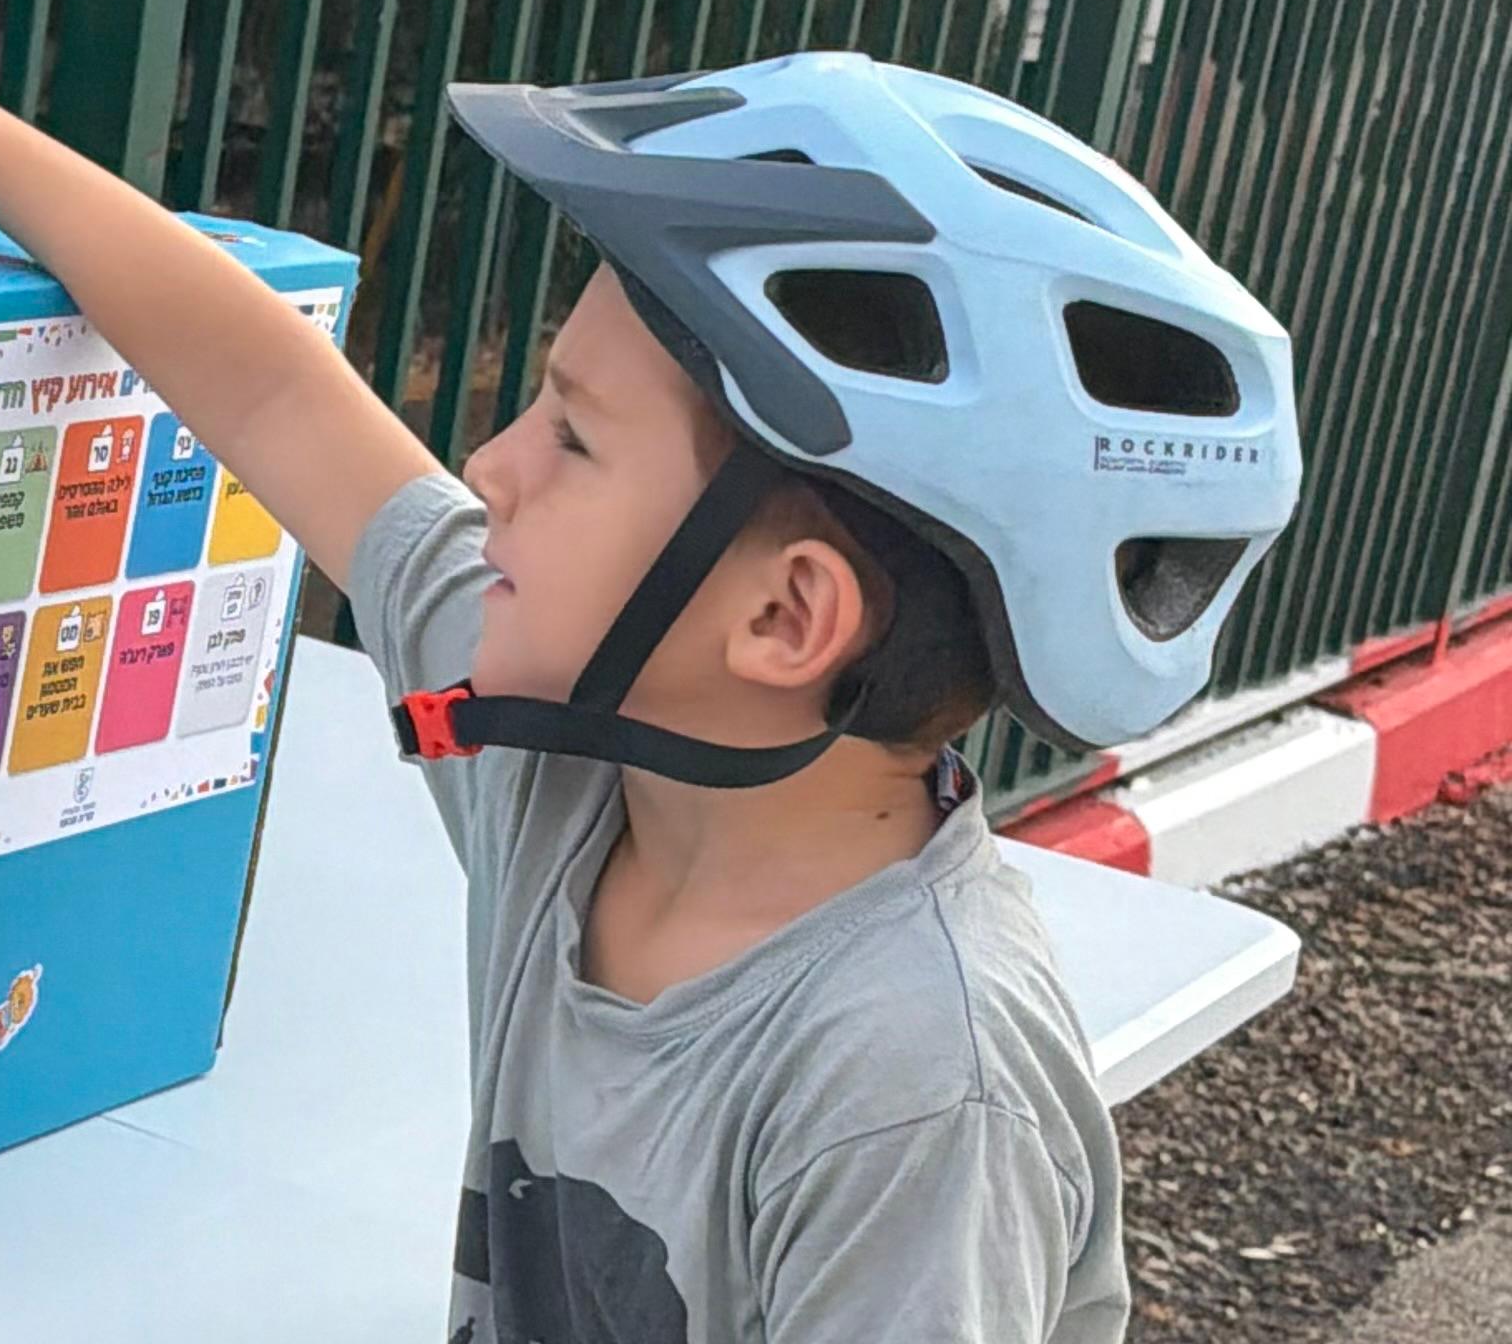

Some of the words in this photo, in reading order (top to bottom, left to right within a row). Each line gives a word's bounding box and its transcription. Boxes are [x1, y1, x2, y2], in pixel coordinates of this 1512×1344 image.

[31, 375, 64, 415] קיץ
[65, 370, 119, 405] אירוע
[1099, 437, 1259, 464] ROCKRIDER
